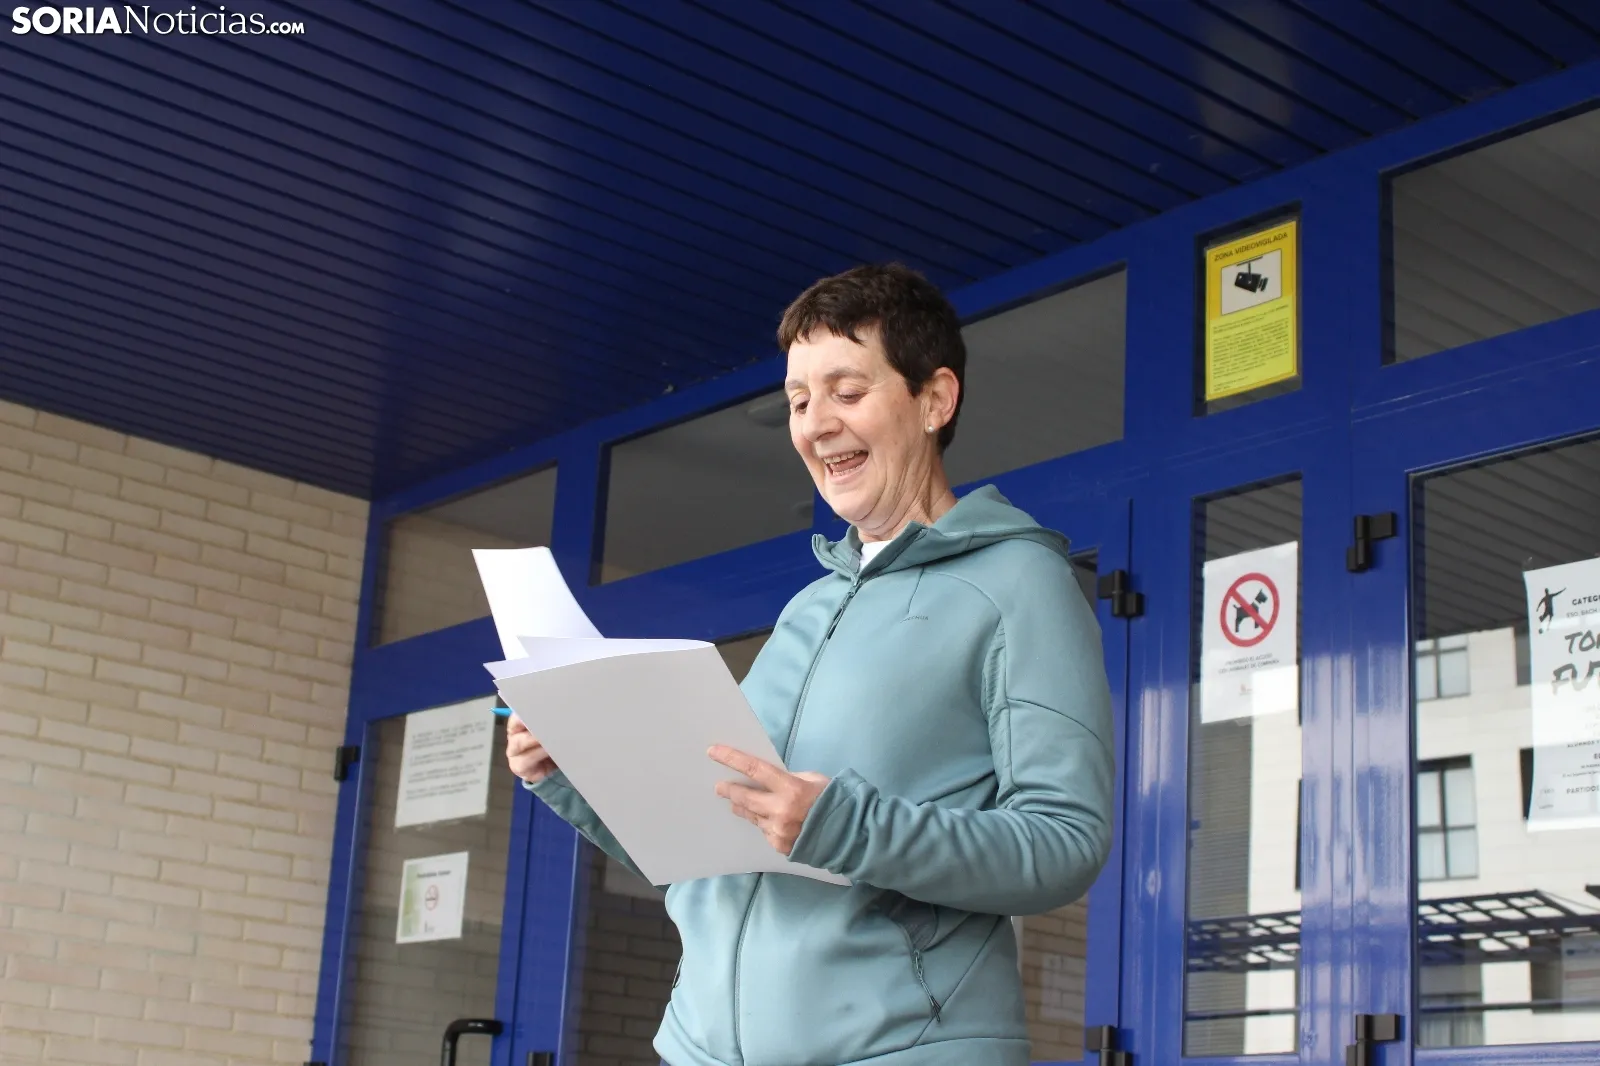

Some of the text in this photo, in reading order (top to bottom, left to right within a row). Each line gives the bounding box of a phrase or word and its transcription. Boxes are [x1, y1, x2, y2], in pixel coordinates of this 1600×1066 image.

[1214, 232, 1288, 262] ZONA VIDEOVIGILADA
[1572, 595, 1600, 605] CATEG
